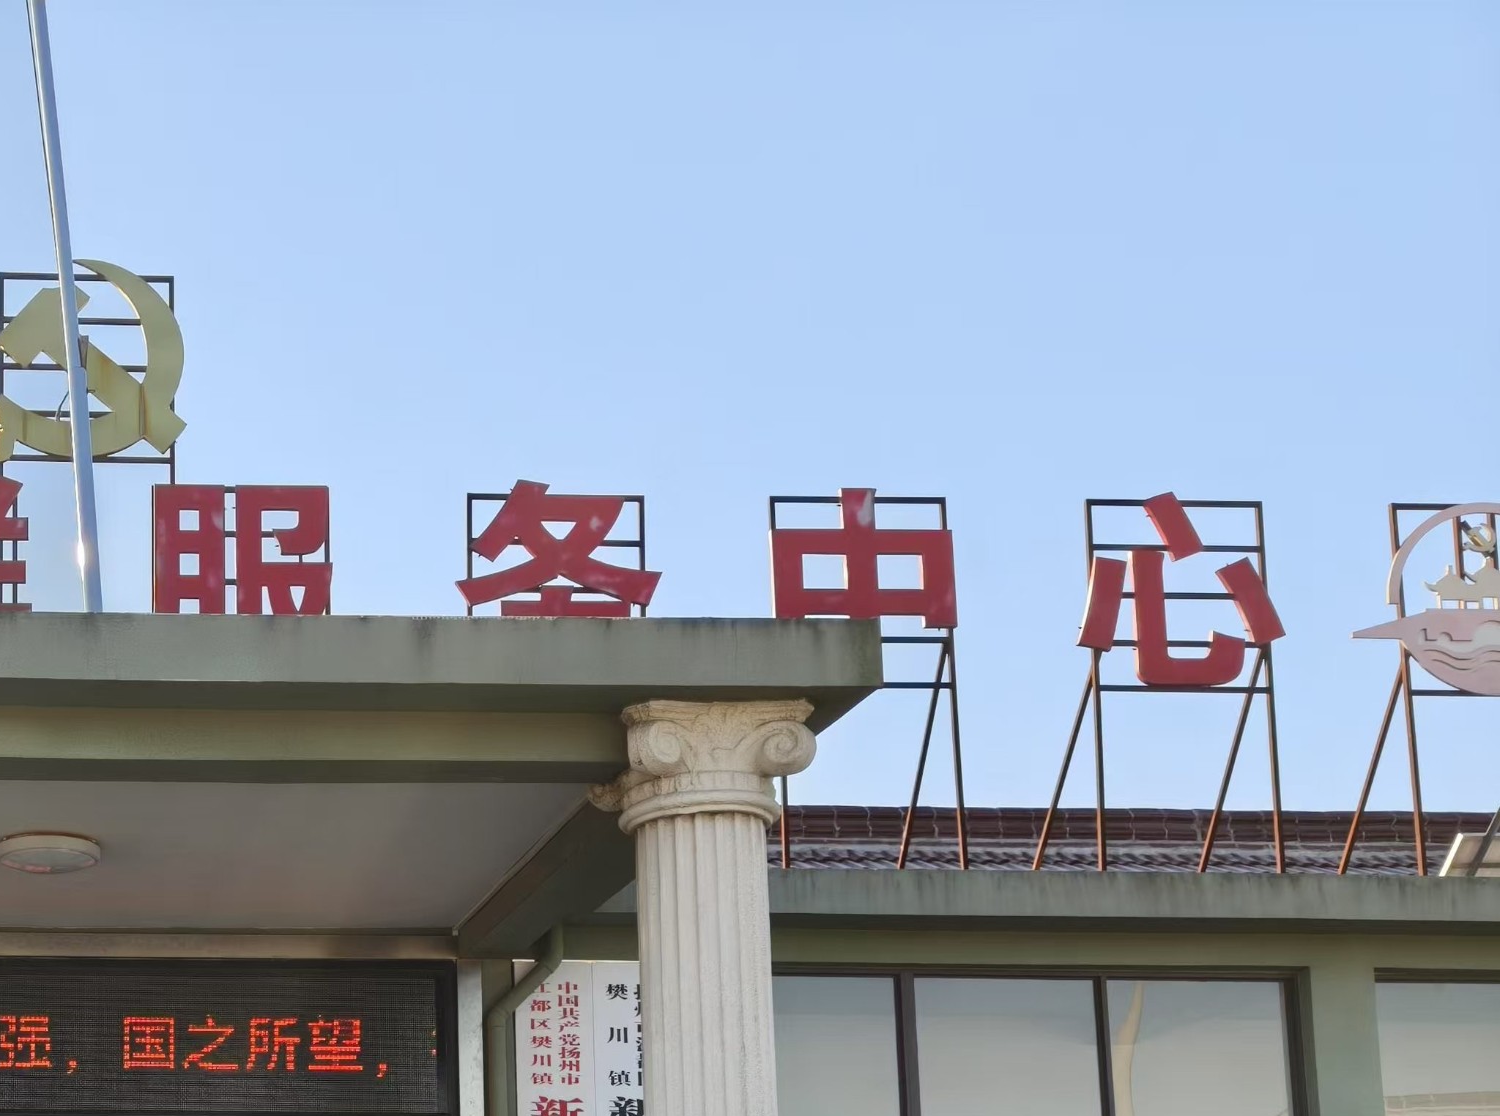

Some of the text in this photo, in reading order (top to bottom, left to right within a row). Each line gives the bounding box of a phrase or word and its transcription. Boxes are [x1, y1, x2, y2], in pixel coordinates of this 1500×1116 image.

[557, 981, 581, 1086] 中国共产党扬州市
[605, 983, 631, 1087] 樊川镇
